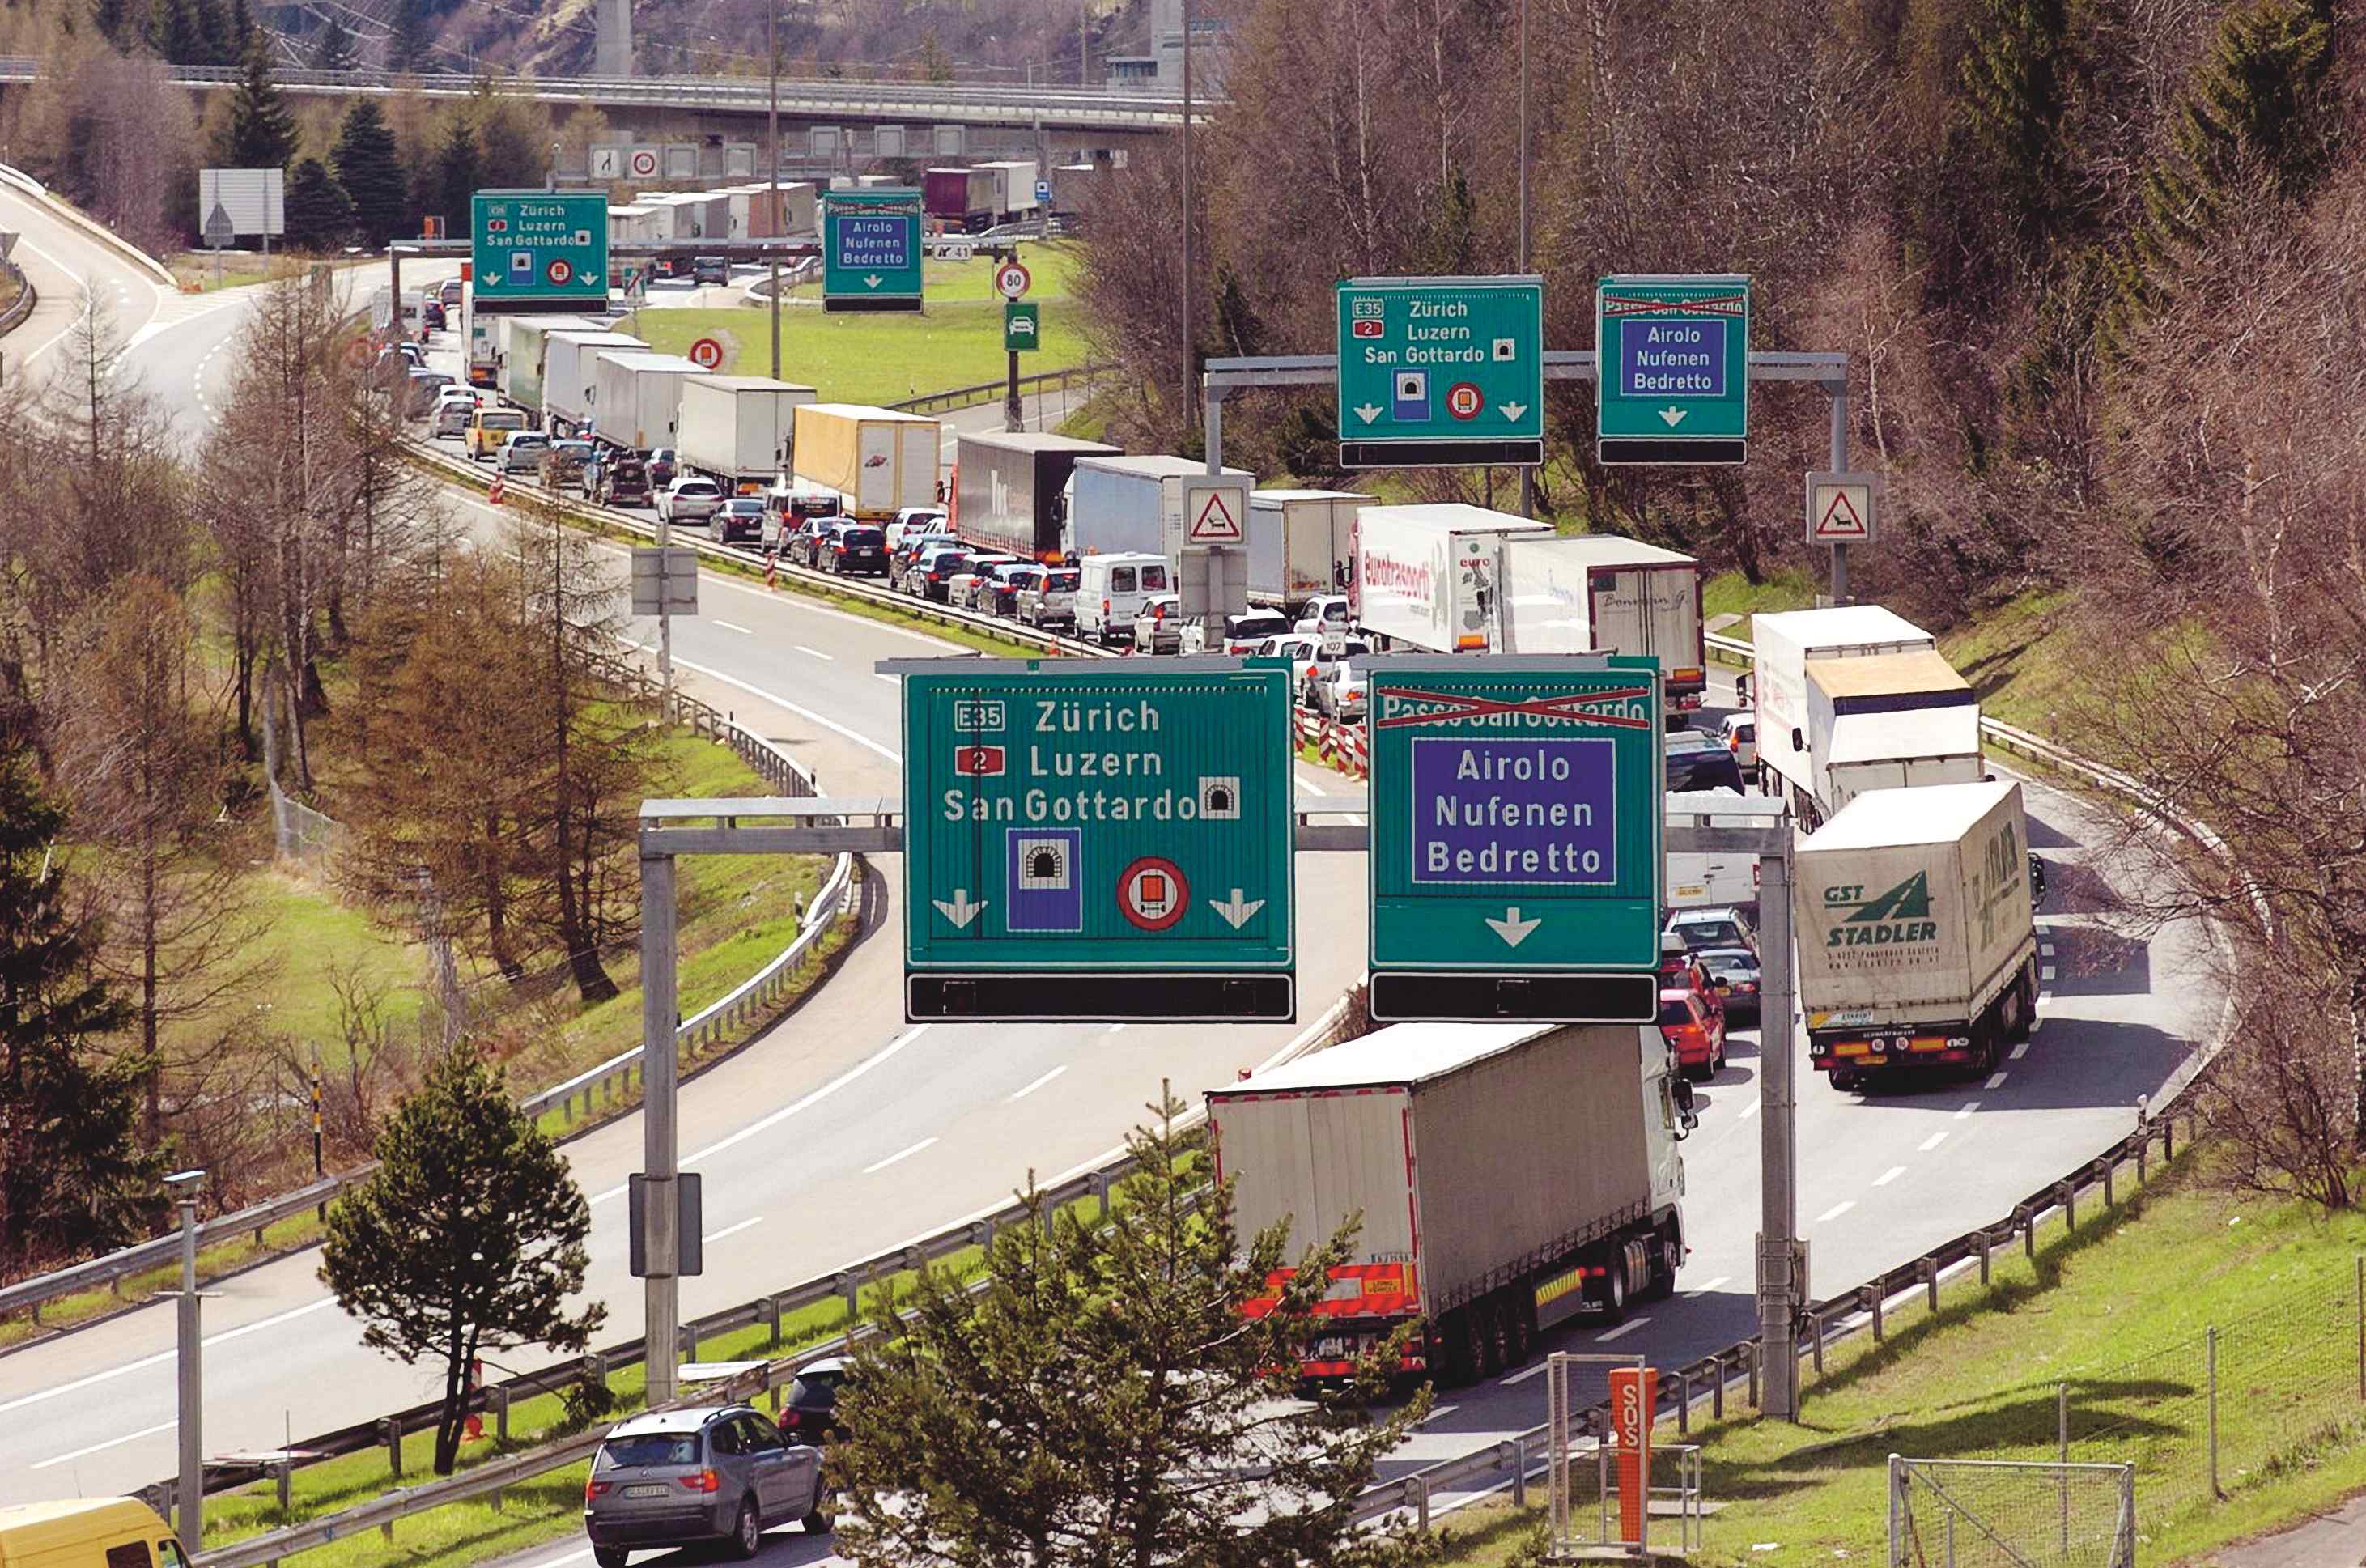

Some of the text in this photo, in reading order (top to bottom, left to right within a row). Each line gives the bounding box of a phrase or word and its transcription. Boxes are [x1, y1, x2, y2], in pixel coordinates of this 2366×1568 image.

[520, 204, 565, 216] Zürich
[518, 219, 566, 232] Luzern
[853, 222, 893, 233] Airolo
[487, 234, 576, 246] San Gottardo
[845, 237, 900, 249] Nufenen
[843, 253, 903, 264] Bedretto
[955, 246, 968, 257] 41
[1006, 274, 1022, 287] 80
[1354, 303, 1382, 315] E35
[1409, 301, 1468, 317] Zürich
[1363, 322, 1373, 334] 2
[1408, 324, 1470, 340] Luzern
[1647, 326, 1700, 342] Airolo
[1365, 346, 1485, 363] San Gottardo
[1637, 350, 1710, 367] Nufenen
[1634, 373, 1712, 389] Bedretto
[1459, 558, 1490, 567] euro
[1325, 642, 1342, 652] 107
[958, 707, 1001, 726] E35
[1034, 700, 1160, 732] Zürich
[972, 751, 987, 770] 2
[1030, 745, 1162, 776] Luzern
[1457, 749, 1570, 780] Airolo
[944, 788, 1196, 821] San Gottardo
[1435, 795, 1592, 826] Nufenen
[1427, 841, 1600, 873] Bedretto
[1824, 885, 1864, 902] GST
[1826, 921, 1937, 947] STADLER
[1622, 1384, 1639, 1447] SOS
